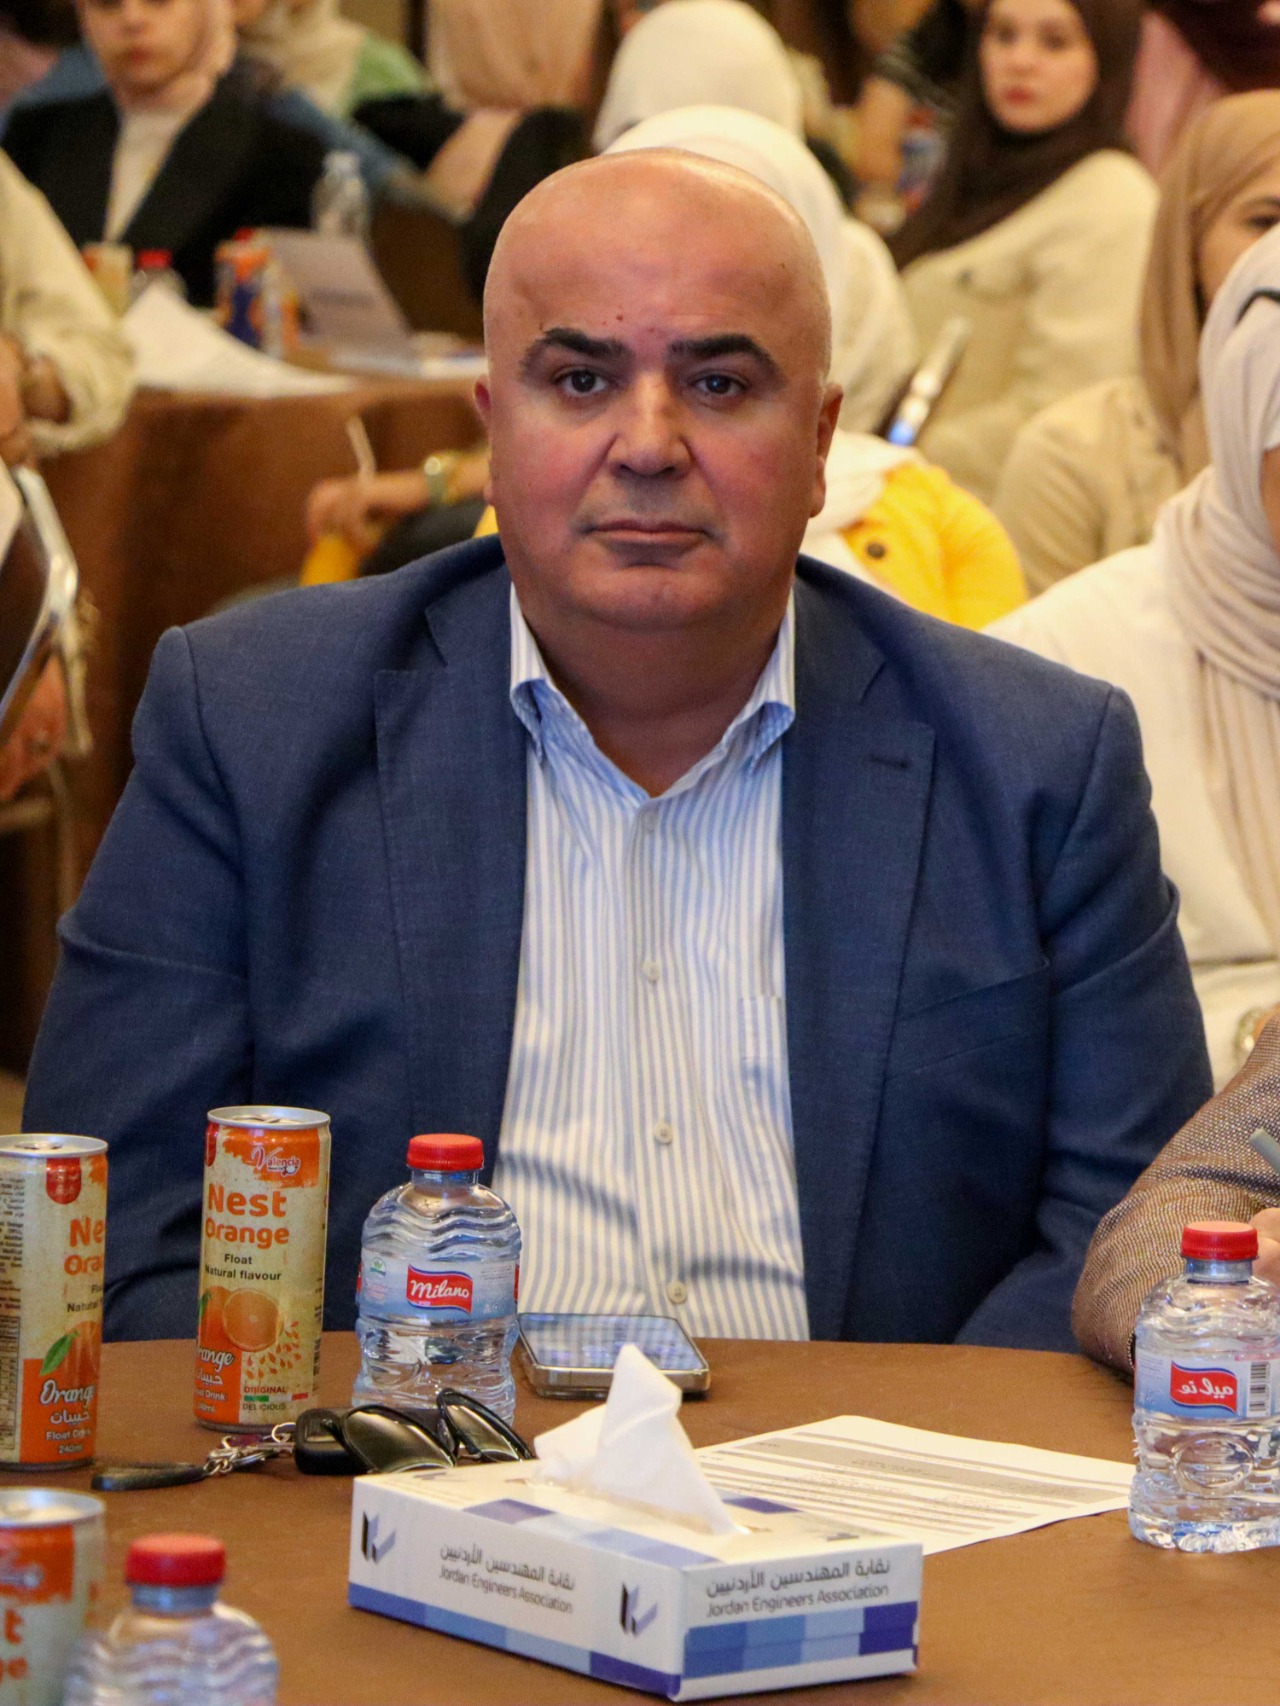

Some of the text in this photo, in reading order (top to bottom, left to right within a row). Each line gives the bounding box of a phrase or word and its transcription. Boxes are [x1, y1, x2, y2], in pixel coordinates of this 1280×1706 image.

[208, 1183, 287, 1218] Nest
[69, 1217, 105, 1248] Ne
[205, 1217, 290, 1250] Orange
[64, 1254, 104, 1276] Ora
[204, 1264, 282, 1281] Natural flavour
[224, 1254, 253, 1265] Float
[410, 1279, 470, 1299] Milano
[40, 1380, 96, 1408] Orang
[438, 1564, 574, 1614] Jordan Engineers Association
[706, 1557, 891, 1599] نقابة المهندسين الأردنيين
[706, 1584, 889, 1618] Jordan Engineers Association
